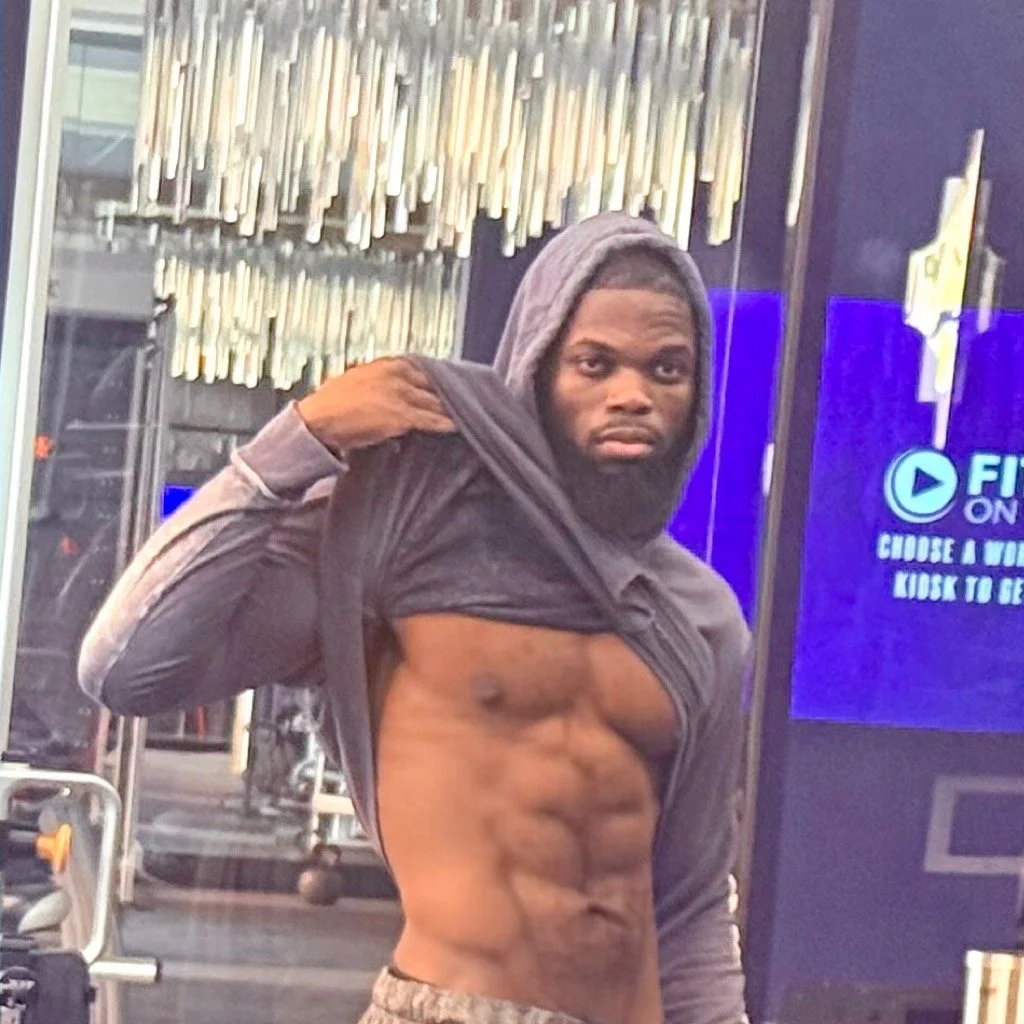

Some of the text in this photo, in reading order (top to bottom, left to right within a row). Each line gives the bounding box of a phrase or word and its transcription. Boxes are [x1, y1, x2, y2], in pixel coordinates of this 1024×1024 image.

[967, 453, 1024, 498] FI
[964, 496, 1018, 525] ON
[878, 532, 955, 565] CHOOSE
[961, 538, 976, 565] A
[893, 570, 958, 602] KIOSK
[965, 575, 993, 604] TO
